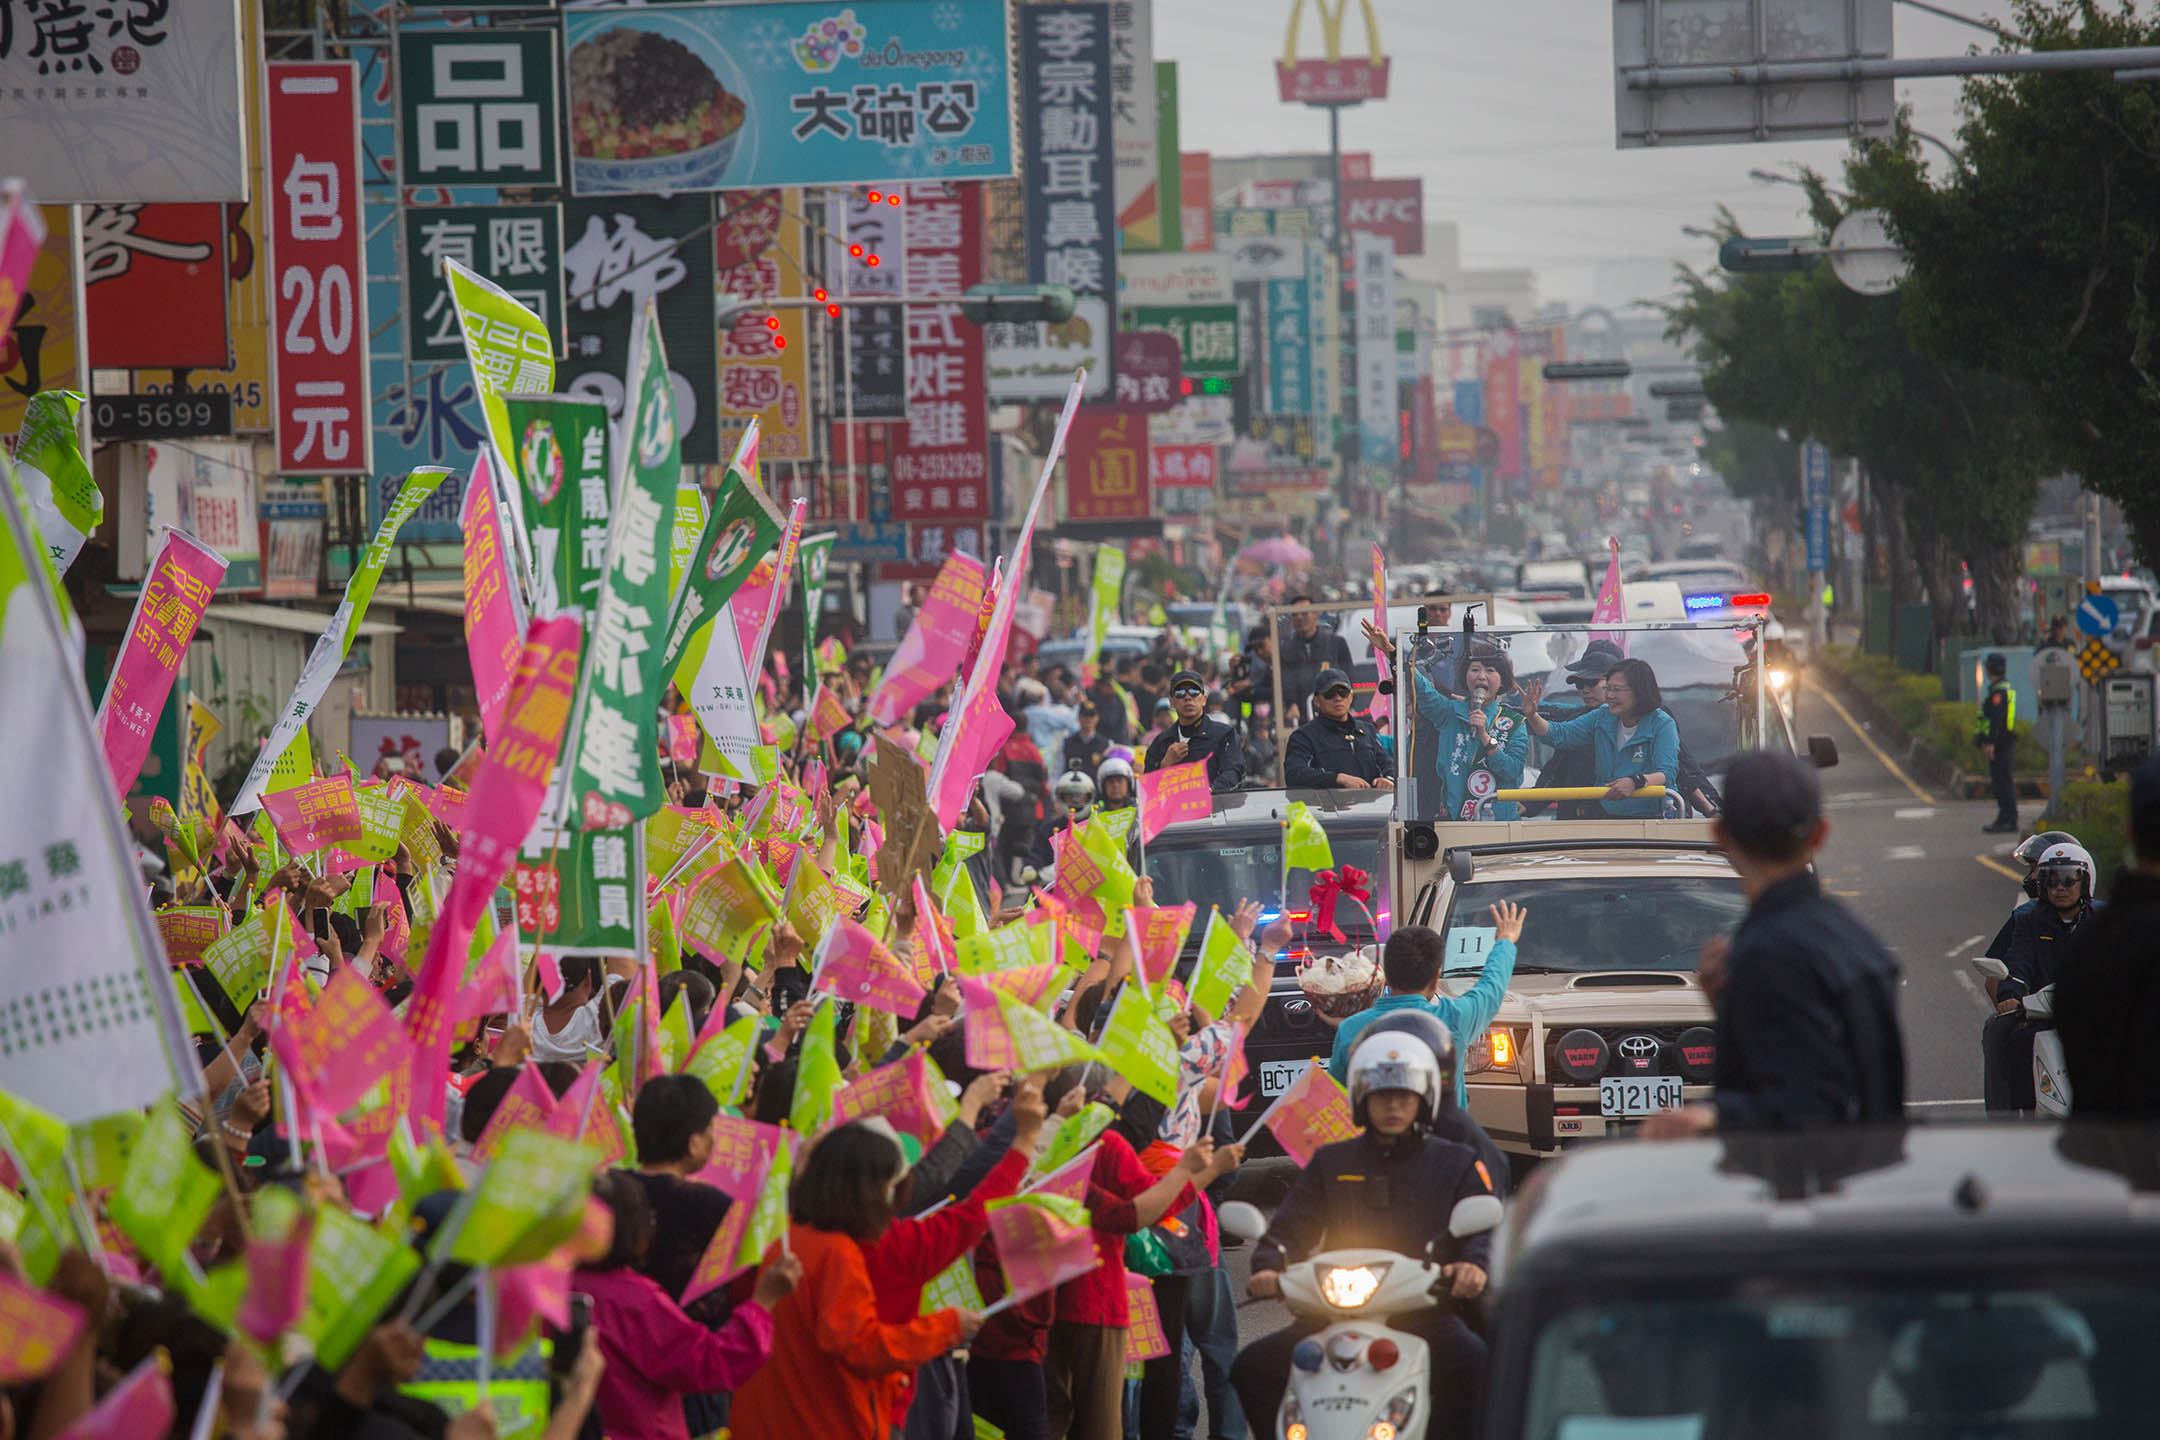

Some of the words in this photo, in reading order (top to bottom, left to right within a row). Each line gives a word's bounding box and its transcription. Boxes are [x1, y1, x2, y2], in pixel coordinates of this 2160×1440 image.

[793, 81, 976, 144] 大碗公
[1348, 198, 1417, 223] KFC
[421, 217, 547, 277] 有限
[281, 77, 353, 462] 一包20元
[1474, 773, 1491, 794] 3
[1459, 936, 1484, 954] 11
[1569, 1053, 1595, 1062] WARN
[1560, 1121, 1580, 1130] ARB
